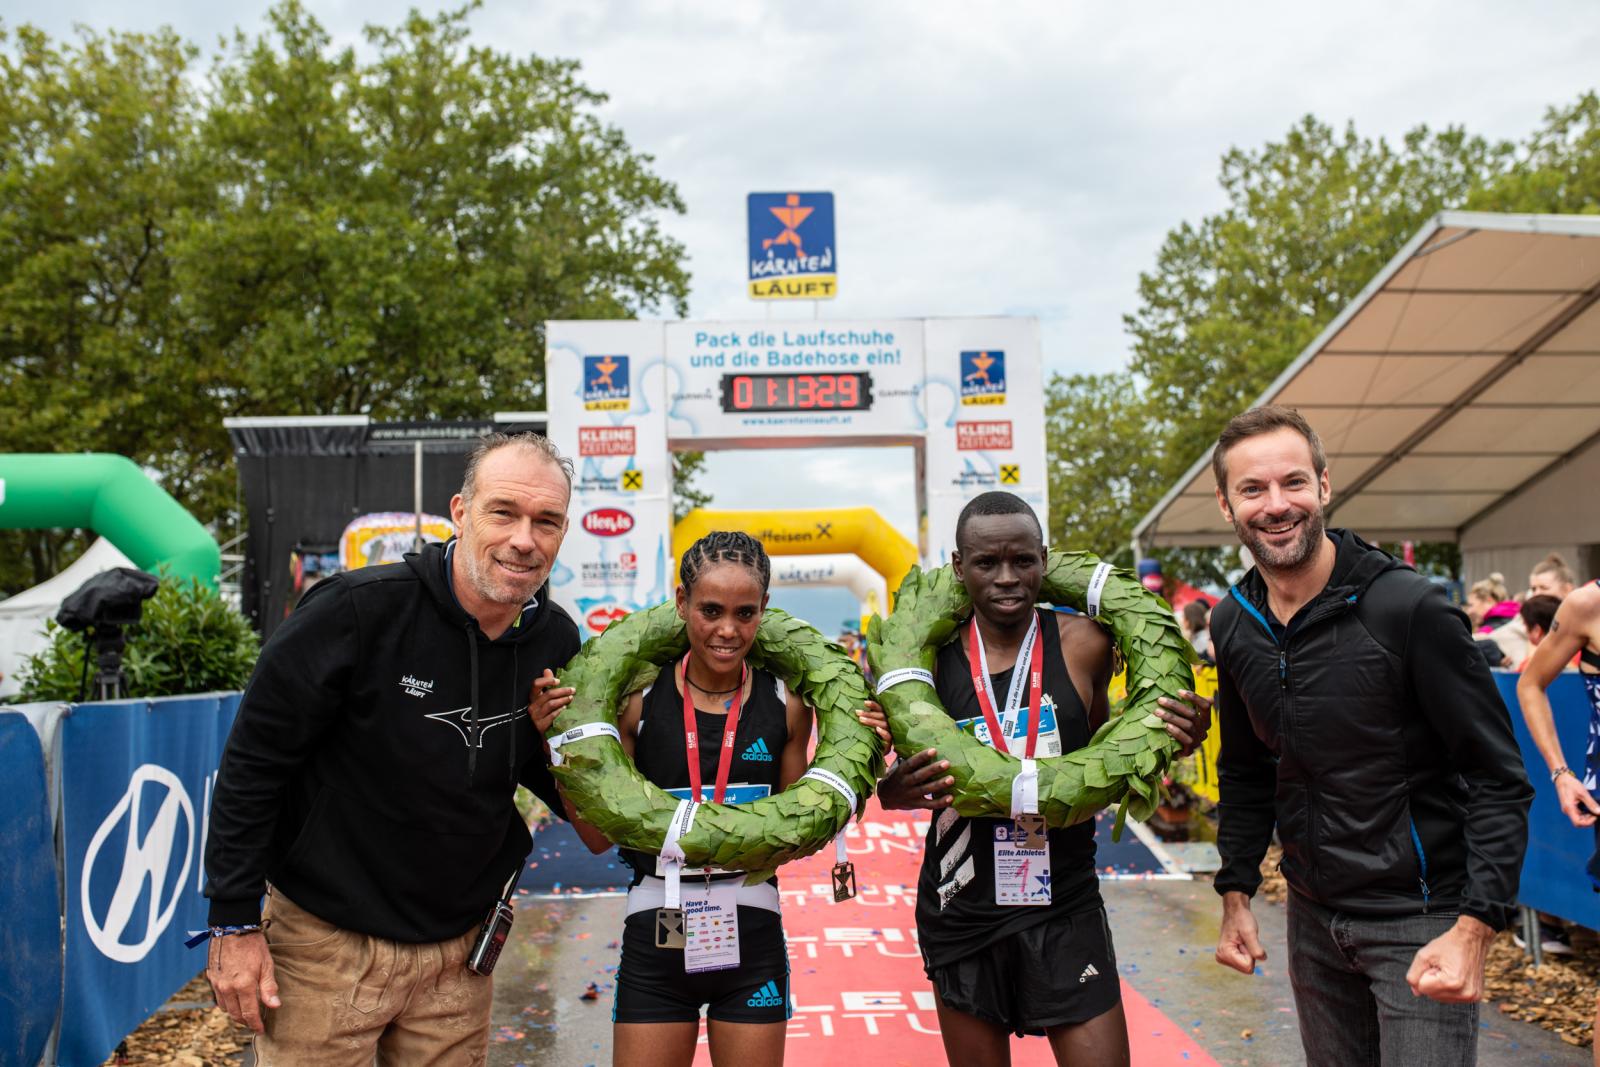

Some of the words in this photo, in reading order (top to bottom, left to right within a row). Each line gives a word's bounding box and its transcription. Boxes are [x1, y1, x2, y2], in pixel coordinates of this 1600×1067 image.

[751, 247, 832, 277] KÄRNTEN
[753, 280, 832, 296] LÄUFT
[695, 332, 742, 348] Pack
[747, 331, 776, 347] die
[783, 330, 895, 347] Laufschuhe
[690, 352, 725, 368] und
[732, 352, 760, 367] die
[767, 350, 860, 366] Badehose
[866, 349, 901, 365] ein!
[959, 423, 1010, 435] KLEINE
[580, 430, 634, 441] KLEINE
[580, 441, 634, 453] ZEITUNG
[959, 436, 1010, 448] ZEITUNG
[754, 528, 813, 542] iffeisen
[402, 674, 434, 689] KÄRNTEN
[404, 687, 427, 699] LÄUFT
[741, 752, 773, 762] adidas
[997, 849, 1015, 857] Elite
[1015, 849, 1046, 857] Athletes
[685, 900, 703, 908] Have
[686, 905, 704, 915] good
[704, 904, 722, 912] time.
[747, 996, 783, 1008] adidas
